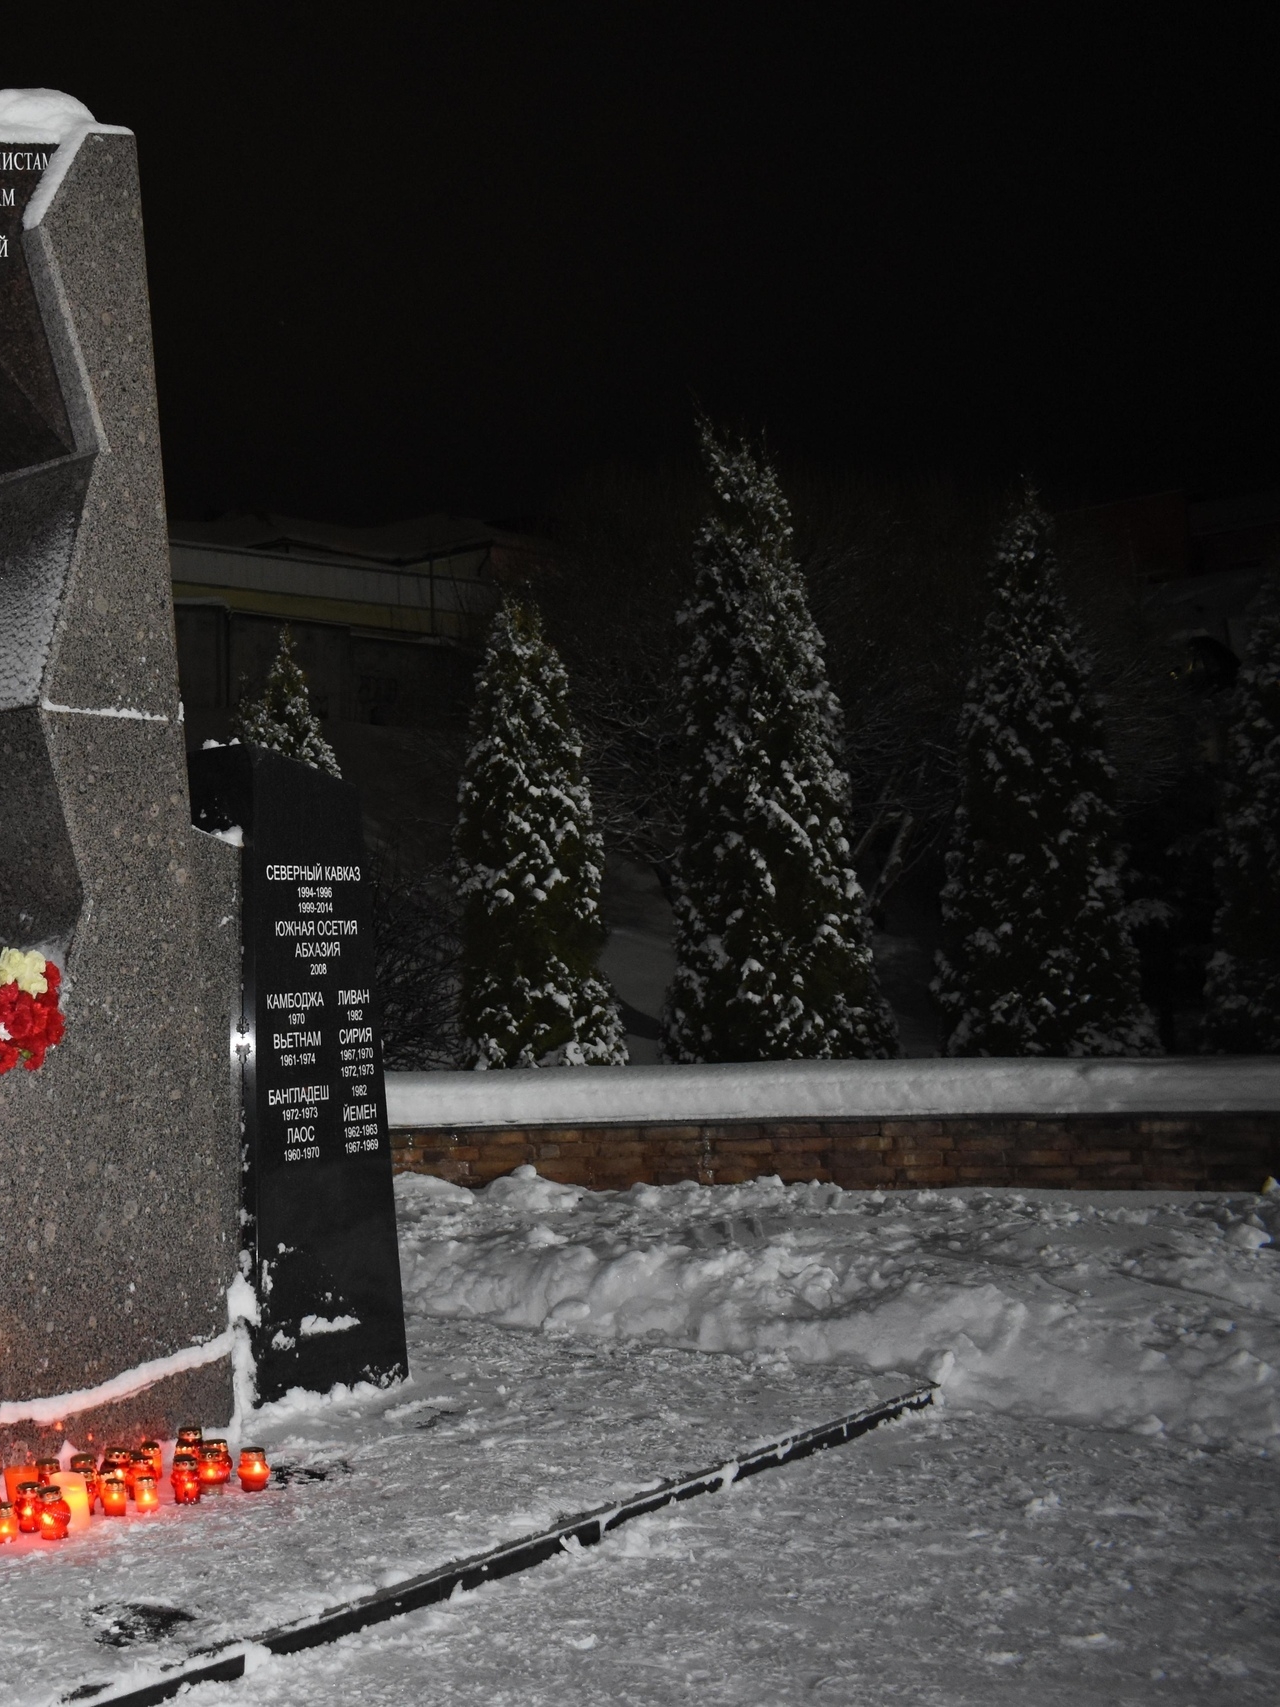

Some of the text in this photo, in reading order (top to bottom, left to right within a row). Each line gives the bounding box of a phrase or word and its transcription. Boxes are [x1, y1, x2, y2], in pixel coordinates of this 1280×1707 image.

[266, 863, 361, 881] СЕВЕРНЫЙ КАВКАЗ
[298, 887, 332, 898] 1994-1996
[298, 902, 333, 913] 1999-2014
[275, 920, 358, 936] ЮЖНАЯ ОСЕТИЯ
[295, 942, 341, 958] АБХАЗИЯ
[311, 964, 327, 975] 2008
[267, 992, 324, 1010] КАМБОДЖА
[338, 989, 370, 1005] ЛИВАН
[288, 1013, 305, 1025] 1970
[347, 1010, 362, 1021] 1982
[273, 1031, 321, 1049] ВЬЕТНАМ
[339, 1028, 372, 1044] СИРИЯ
[280, 1053, 316, 1066] 1961-1974
[340, 1048, 373, 1061] 1967,1970
[341, 1064, 374, 1078] 1972,1973
[268, 1085, 329, 1105] БАНГЛАДЕШ
[282, 1107, 318, 1121] 1972-1973
[343, 1103, 377, 1122] ЙЕМЕН
[287, 1126, 315, 1144] ЛАОС
[344, 1124, 378, 1138] 1962-1963
[345, 1139, 378, 1153] 1967-1969
[284, 1147, 319, 1162] 1960-1970
